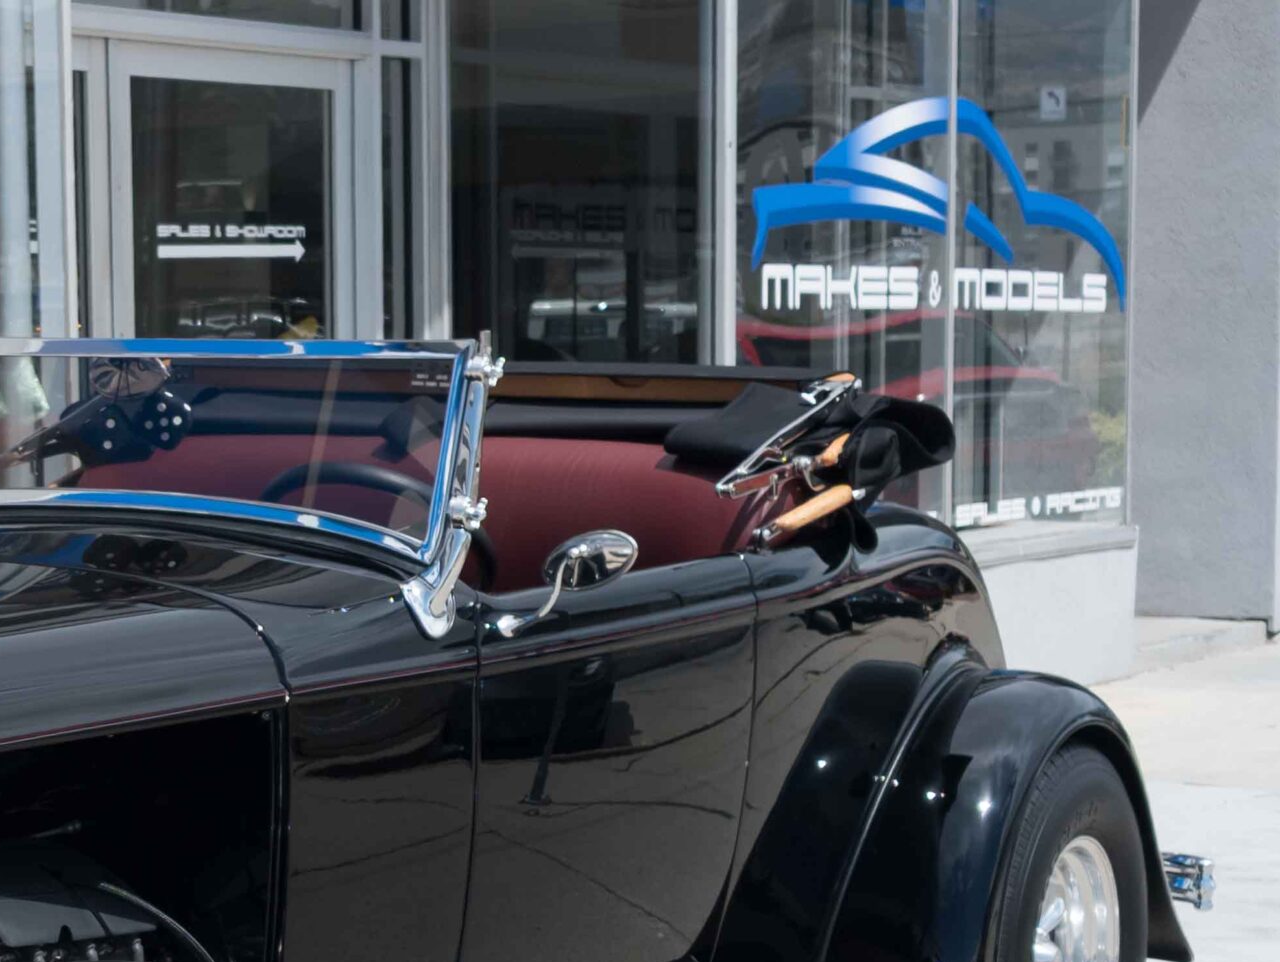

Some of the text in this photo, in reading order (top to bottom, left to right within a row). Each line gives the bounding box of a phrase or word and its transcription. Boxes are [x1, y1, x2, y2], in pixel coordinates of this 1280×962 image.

[156, 224, 306, 239] SALES & SHOWROOM
[762, 264, 1107, 313] MAKES & MODELS
[955, 498, 1026, 527] SALES
